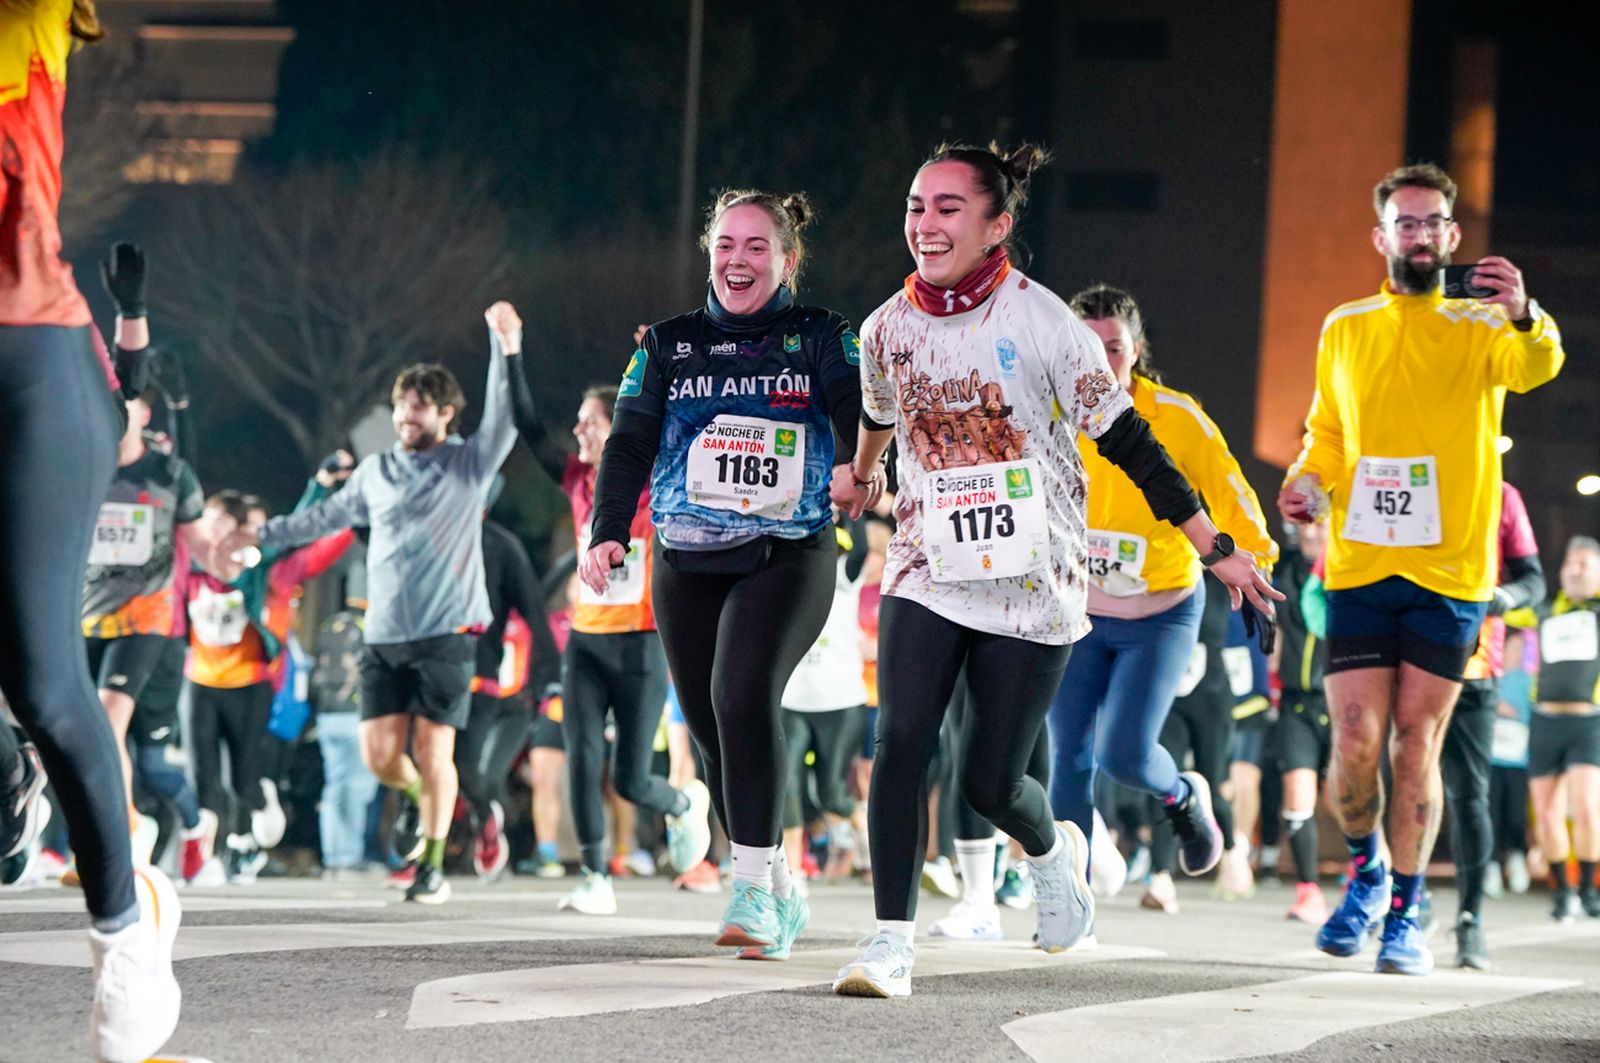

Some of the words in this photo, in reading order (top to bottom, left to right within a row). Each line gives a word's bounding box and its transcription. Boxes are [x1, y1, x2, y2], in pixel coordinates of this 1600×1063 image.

[668, 375, 713, 401] SAN
[720, 367, 811, 397] ANTÓN
[768, 389, 812, 409] 2025
[716, 426, 752, 439] NOCHE
[752, 430, 766, 441] DE
[703, 437, 727, 450] SAN
[727, 438, 766, 454] ANTÓN
[714, 453, 779, 488] 1183
[733, 487, 759, 496] Sandra
[980, 477, 995, 489] DE
[955, 489, 997, 507] ANTÓN
[1374, 490, 1412, 515] 452
[948, 504, 1015, 543] 1173
